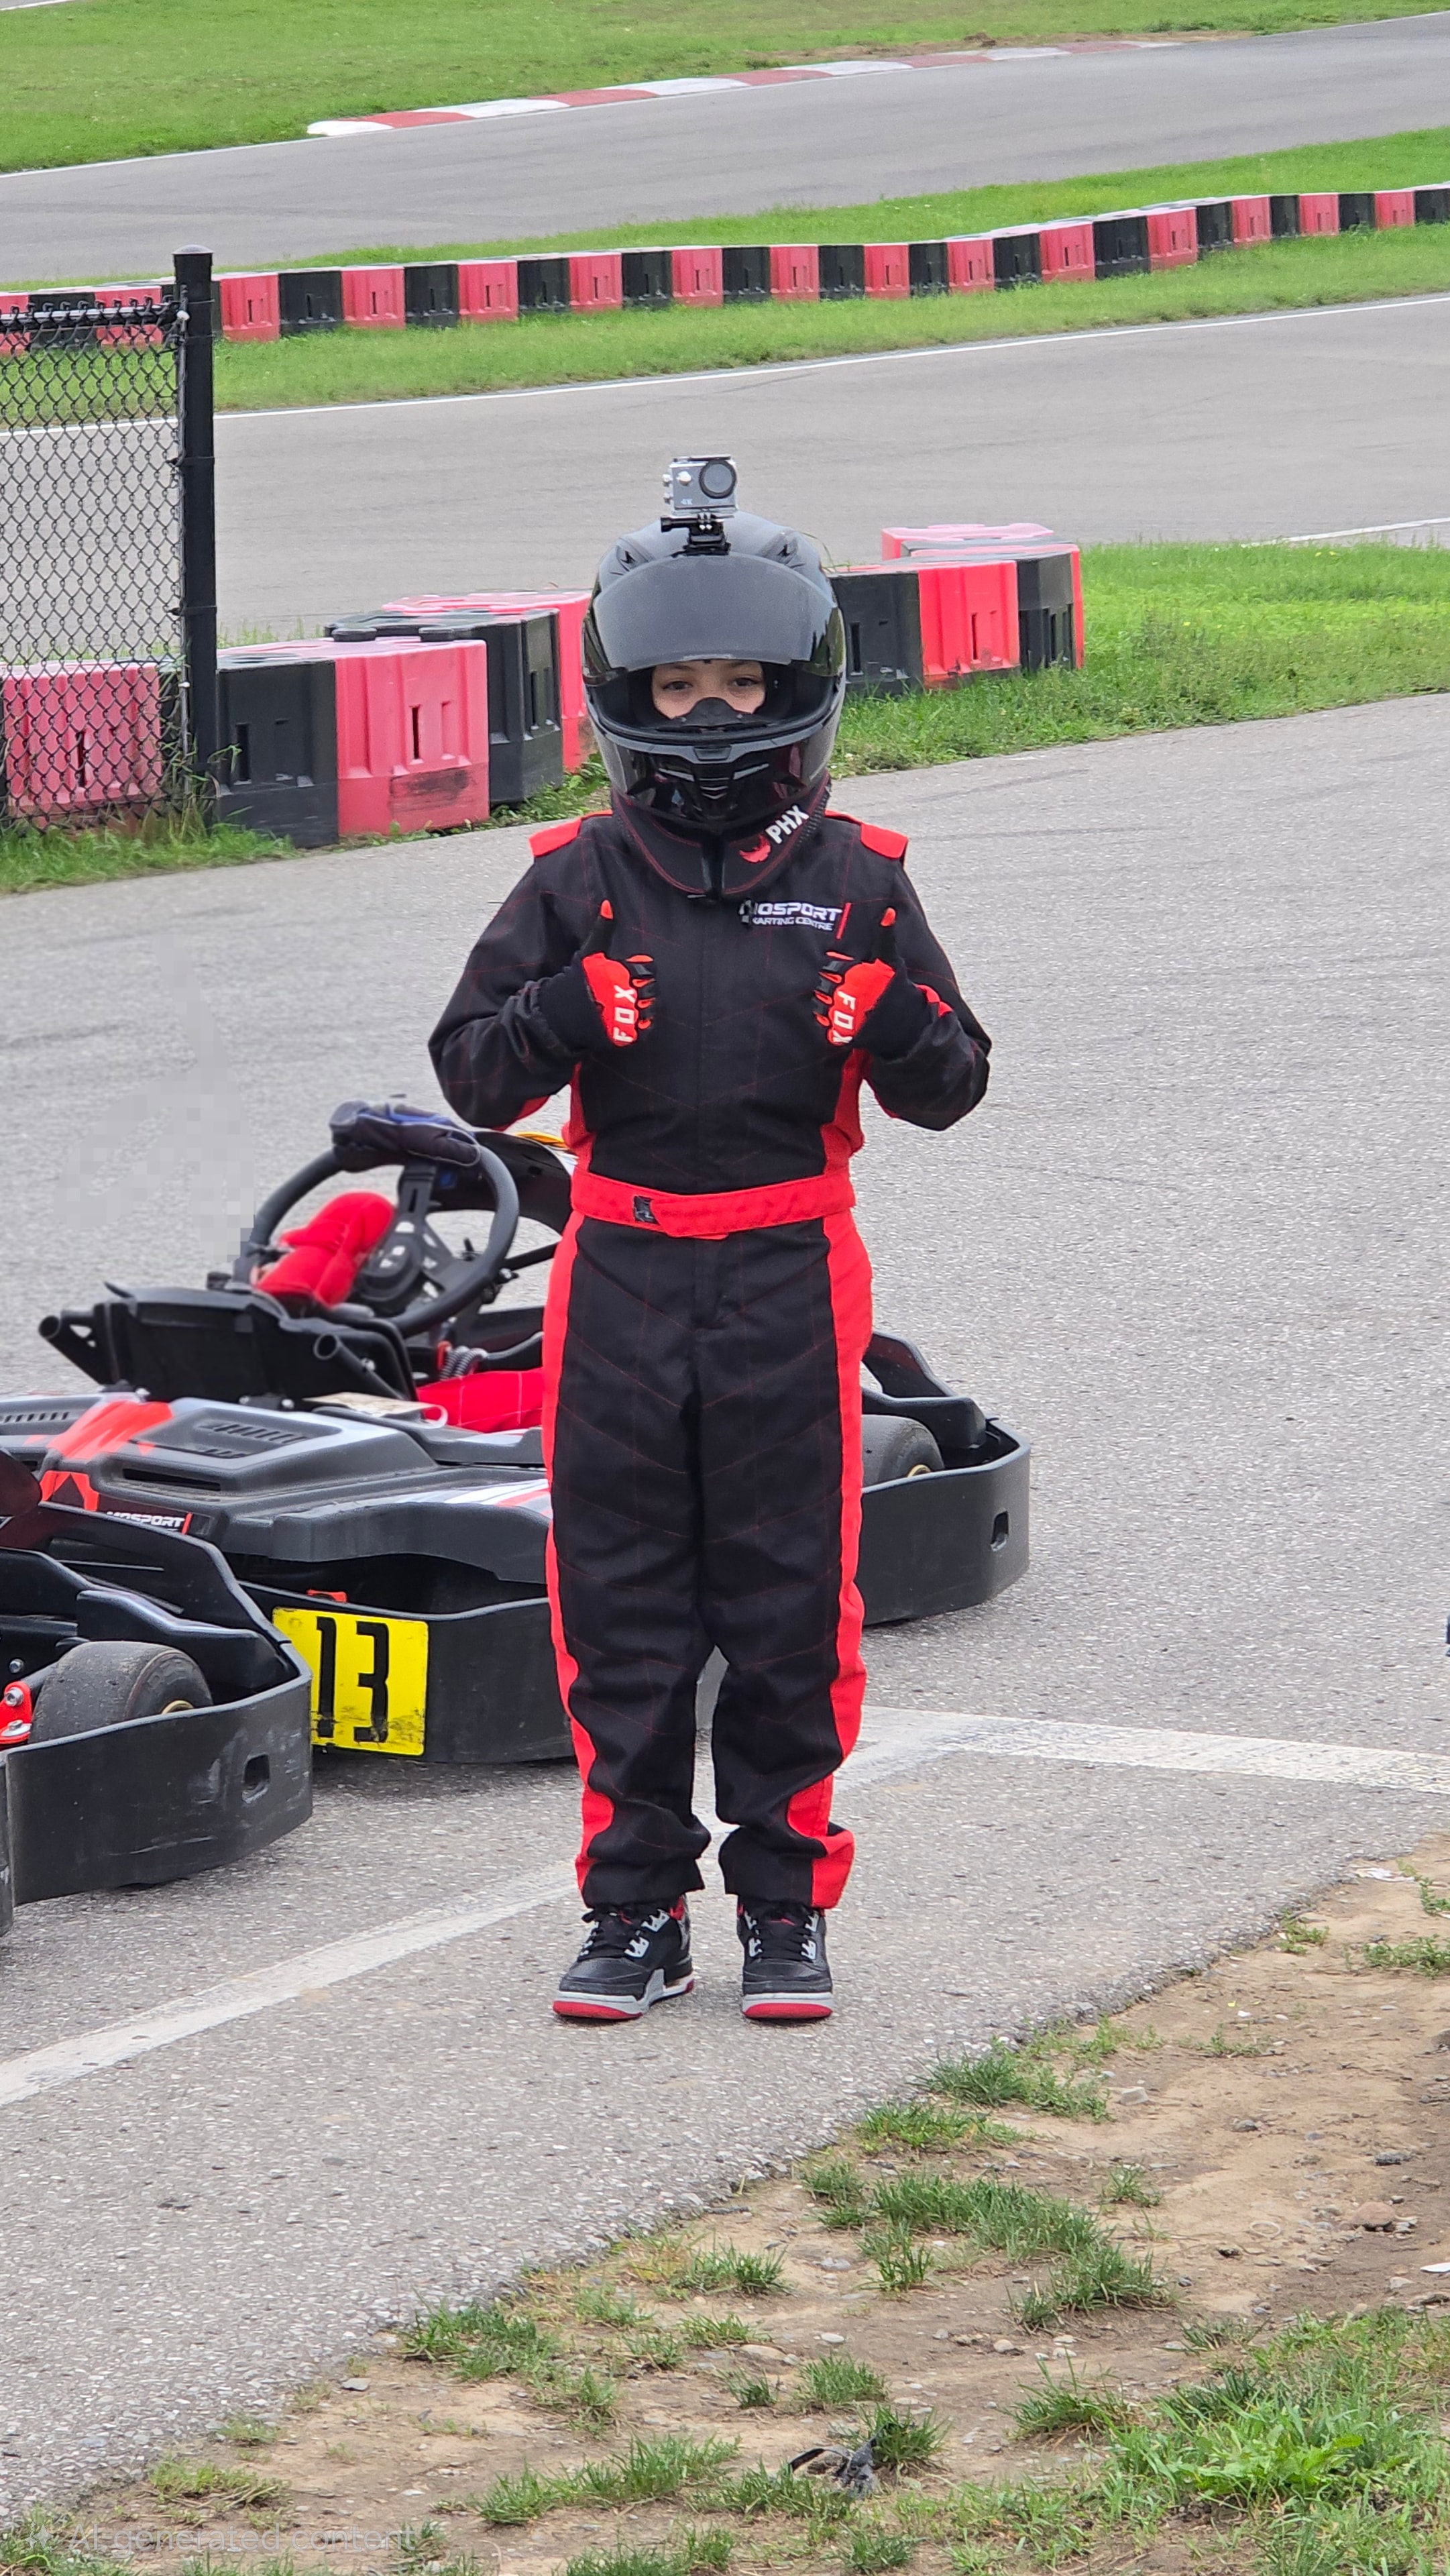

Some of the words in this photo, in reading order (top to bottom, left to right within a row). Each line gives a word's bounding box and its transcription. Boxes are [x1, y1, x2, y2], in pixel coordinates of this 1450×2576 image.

[765, 804, 809, 844] PHX
[613, 987, 636, 1042] FOX
[832, 990, 856, 1043] FOX
[316, 1616, 389, 1743] 13
